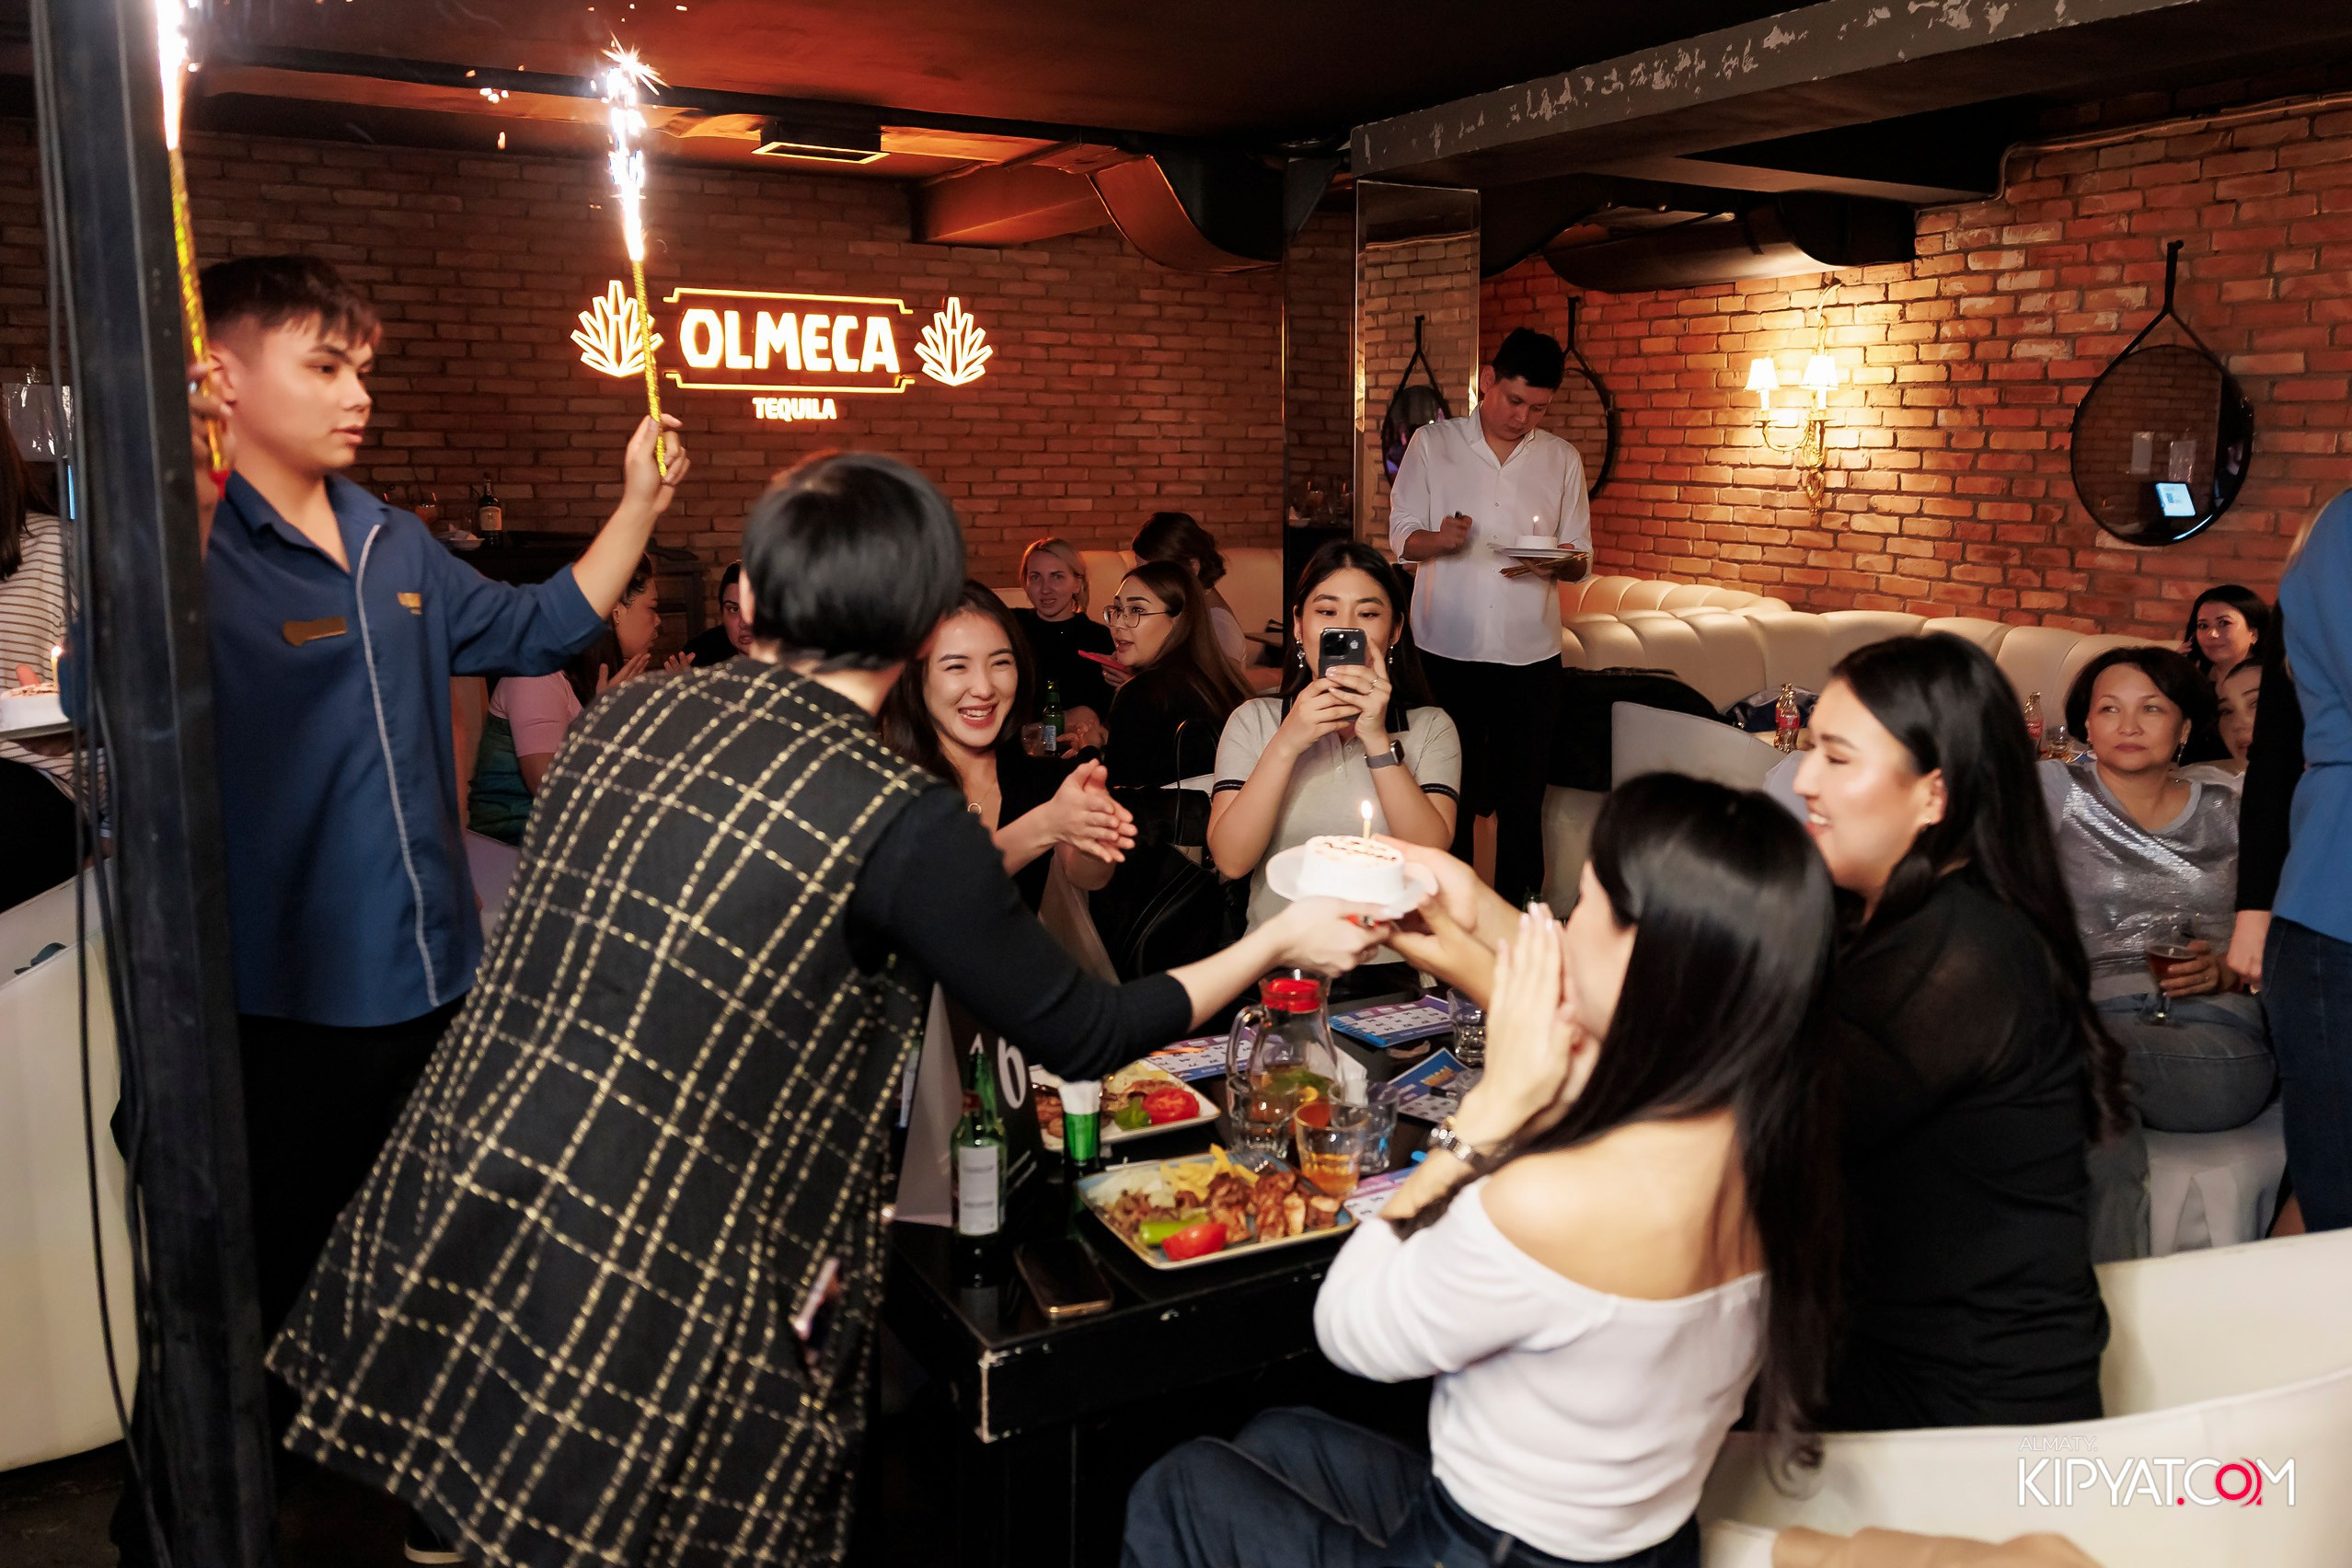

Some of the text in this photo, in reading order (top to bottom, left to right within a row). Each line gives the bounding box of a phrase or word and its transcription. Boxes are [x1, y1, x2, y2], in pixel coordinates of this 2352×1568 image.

[679, 308, 900, 374] OLMECA
[752, 398, 837, 422] TEQUILA
[969, 1032, 1028, 1111] 0
